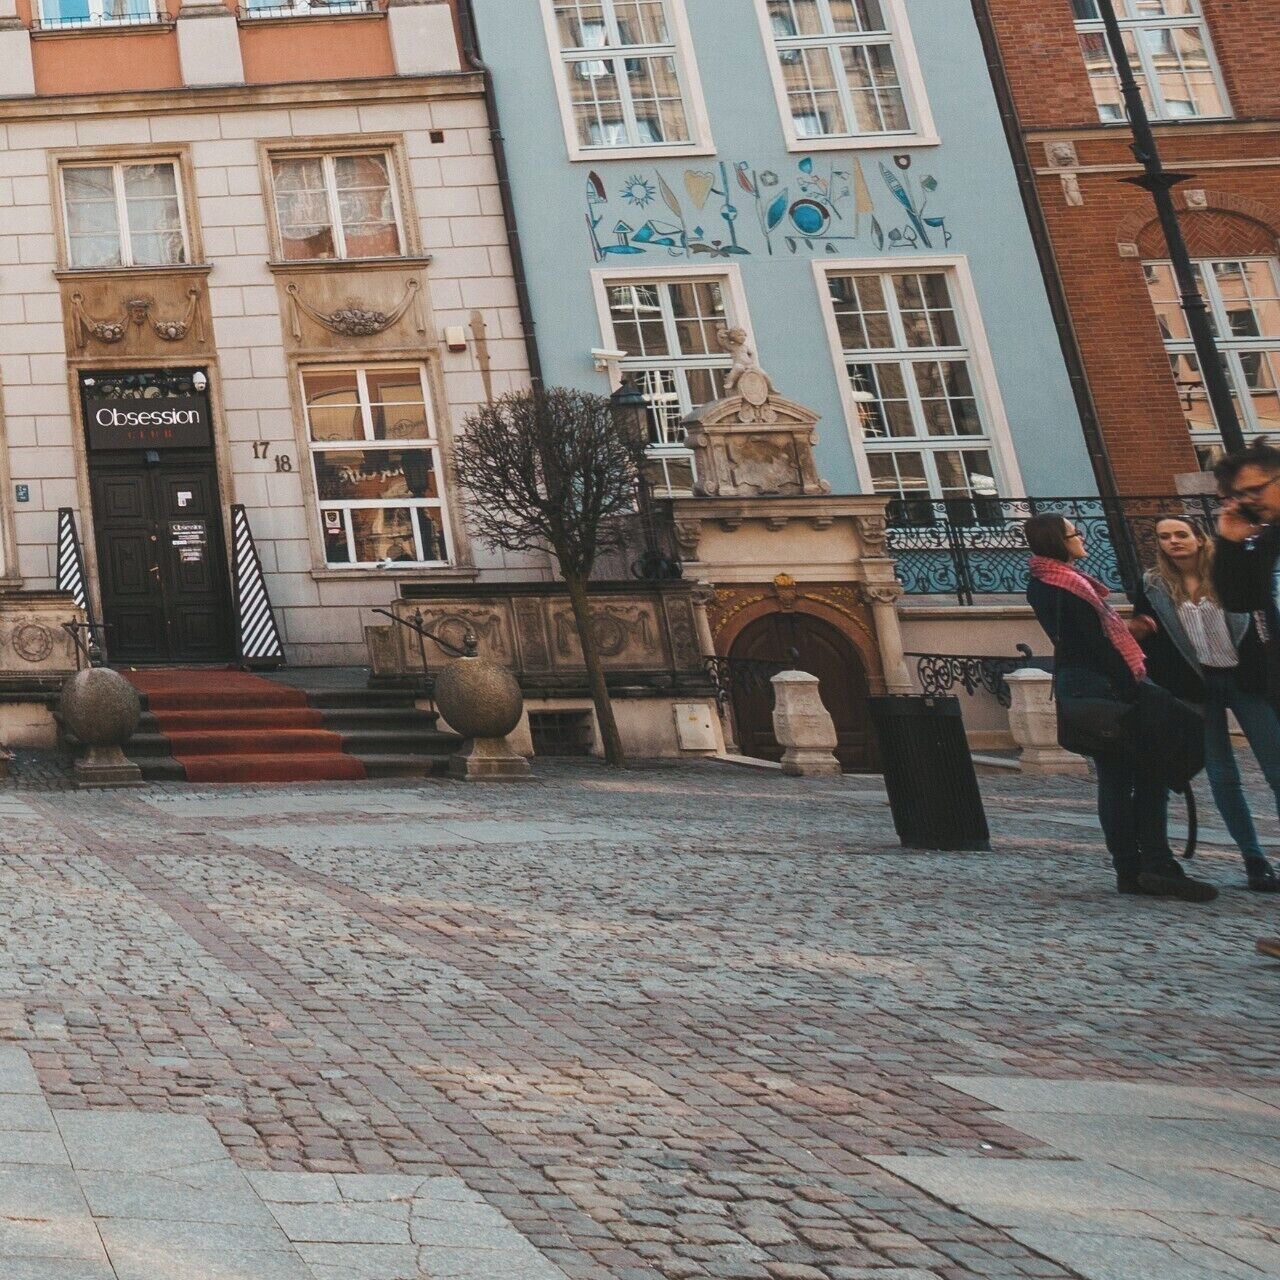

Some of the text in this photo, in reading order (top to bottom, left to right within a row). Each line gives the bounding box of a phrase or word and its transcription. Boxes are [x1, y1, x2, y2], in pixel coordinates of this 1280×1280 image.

[96, 408, 200, 426] Obsession
[253, 441, 270, 459] 17
[275, 455, 292, 472] 18
